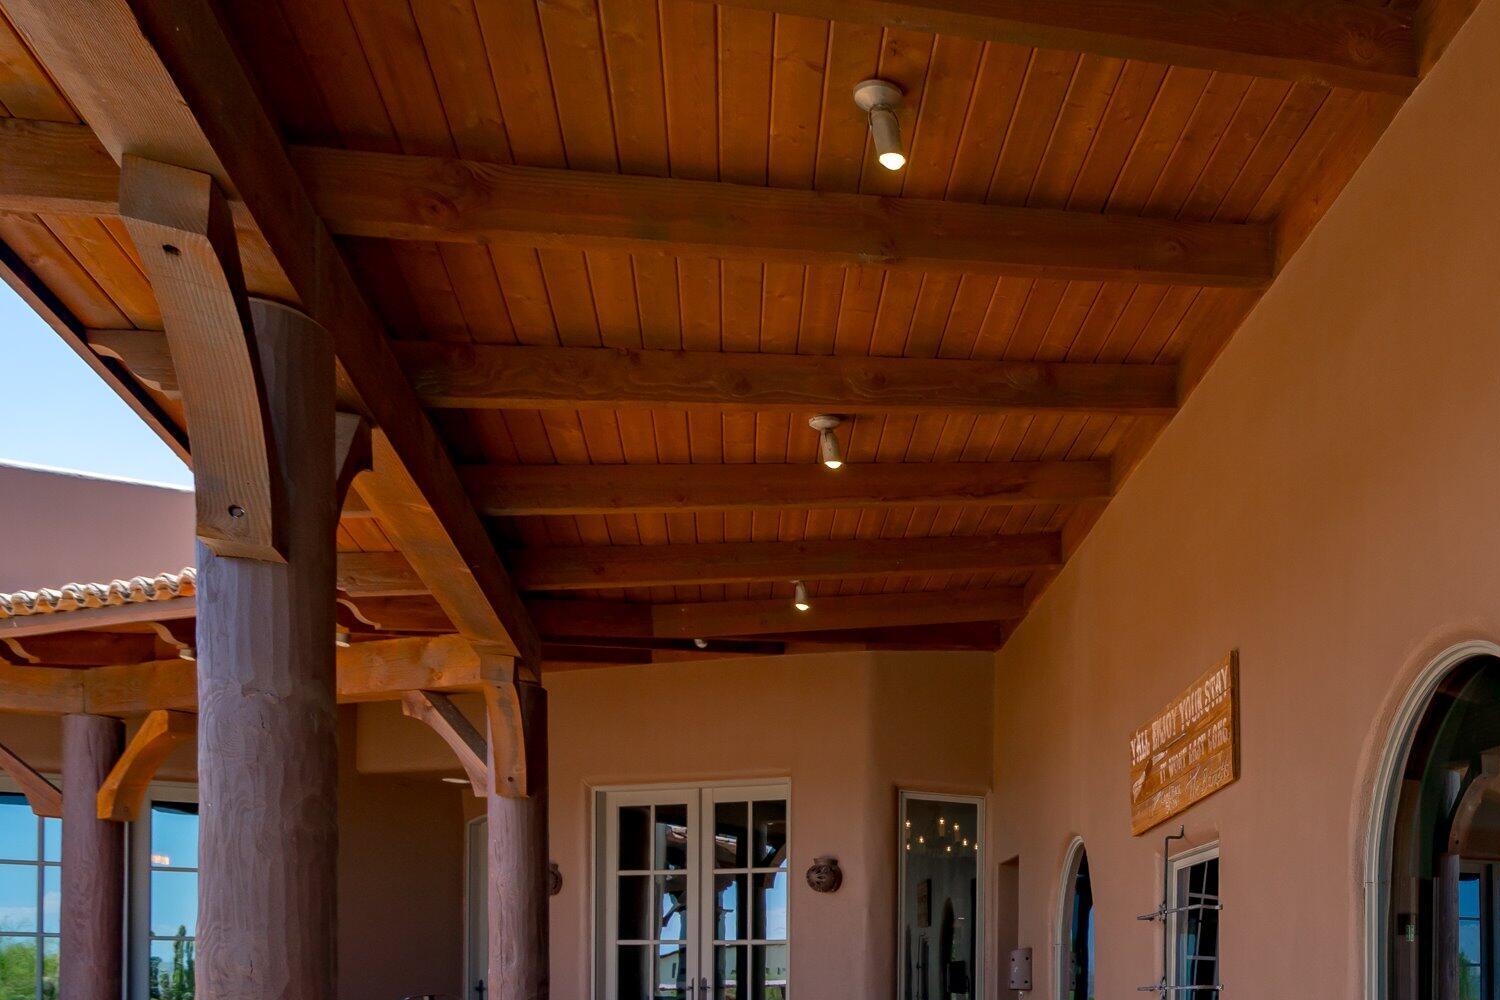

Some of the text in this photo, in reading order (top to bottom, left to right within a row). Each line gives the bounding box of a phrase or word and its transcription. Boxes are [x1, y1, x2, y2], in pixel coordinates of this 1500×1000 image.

[1151, 706, 1177, 751] ENJOY
[1179, 687, 1204, 732] YOUR
[1204, 665, 1229, 712] STAY
